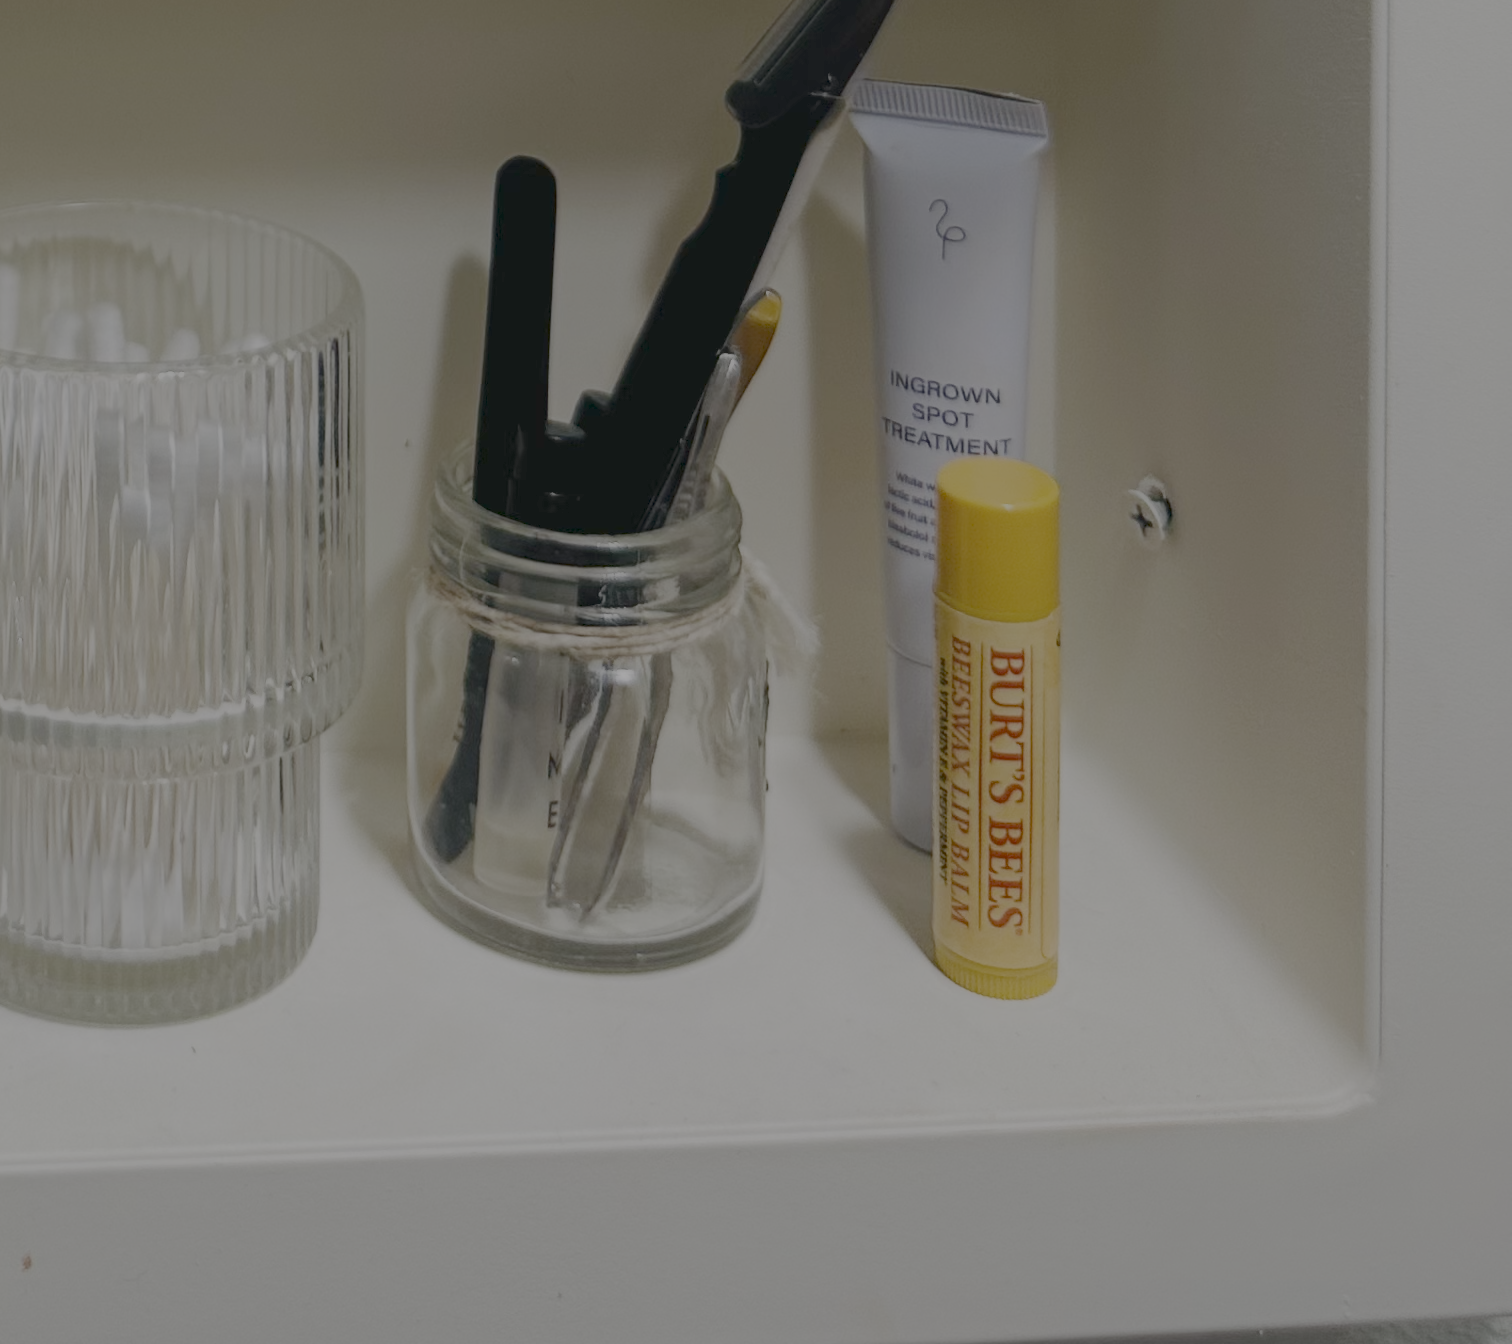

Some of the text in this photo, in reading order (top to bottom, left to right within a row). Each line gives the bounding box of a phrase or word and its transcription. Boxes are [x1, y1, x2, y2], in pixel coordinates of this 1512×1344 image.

[889, 369, 1001, 405] INGROWN
[912, 402, 974, 429] SPOT
[881, 416, 1012, 456] TREATMENT
[940, 690, 949, 756] VITAMIN
[950, 634, 971, 929] BEESWAX LIP BALM
[987, 647, 1025, 929] BURT'S BEES
[939, 785, 948, 886] PEPPERMINT
